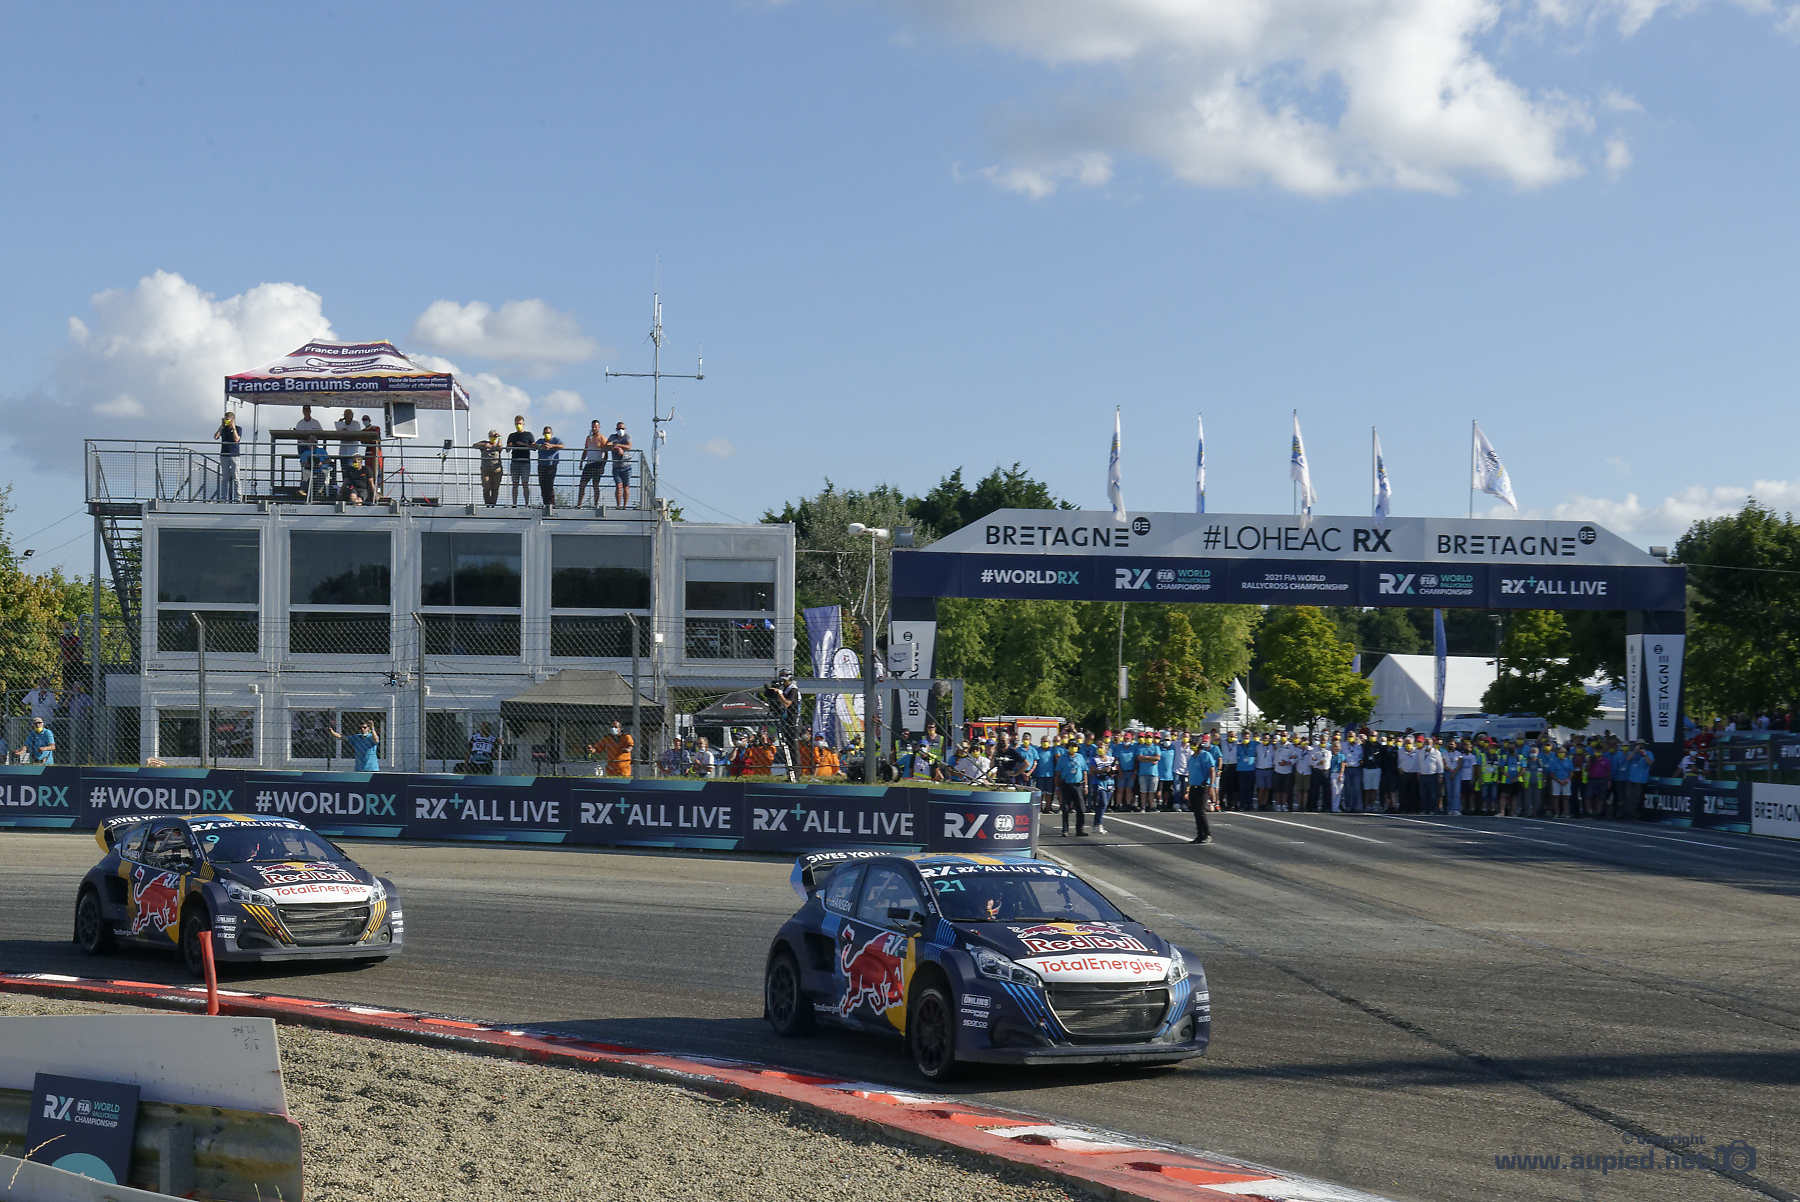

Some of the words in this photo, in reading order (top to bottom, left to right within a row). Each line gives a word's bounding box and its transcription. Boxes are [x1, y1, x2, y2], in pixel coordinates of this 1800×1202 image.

[304, 346, 339, 355] France
[986, 525, 1129, 547] BRETAGNE
[1203, 525, 1342, 551] #LOHEAC
[1352, 528, 1392, 553] RX
[1437, 534, 1576, 556] BRETAGNE
[980, 569, 1080, 585] #WORLDRX
[1115, 568, 1152, 590] RX
[1177, 569, 1211, 577] WORLD
[1297, 574, 1326, 582] WORLD
[1440, 574, 1473, 582] WORLD
[1241, 582, 1288, 590] RALLYCROSS
[1289, 583, 1349, 591] CHAMPIONSHIP
[1379, 573, 1416, 595] RX
[1570, 581, 1607, 595] LIVE
[1658, 655, 1670, 728] BRETAGNE
[90, 786, 234, 811] #WORLDRX
[255, 790, 397, 816] #WORLDRX
[510, 800, 560, 823] LIVE
[679, 805, 731, 830] LIVE
[858, 811, 914, 837] LIVE
[943, 812, 989, 839] RX
[205, 834, 220, 844] 9
[806, 851, 847, 864] GIVES
[920, 865, 958, 878] RX
[1012, 865, 1040, 873] LIVE
[272, 884, 367, 897] TotalEnergies
[934, 879, 966, 893] 21
[1021, 935, 1090, 953] Red
[1090, 935, 1149, 952] Bull
[1037, 958, 1163, 974] TotalEnergies
[43, 1094, 74, 1122] RX
[93, 1101, 121, 1113] WORLD
[74, 1115, 118, 1128] CHAMPIONSHIP
